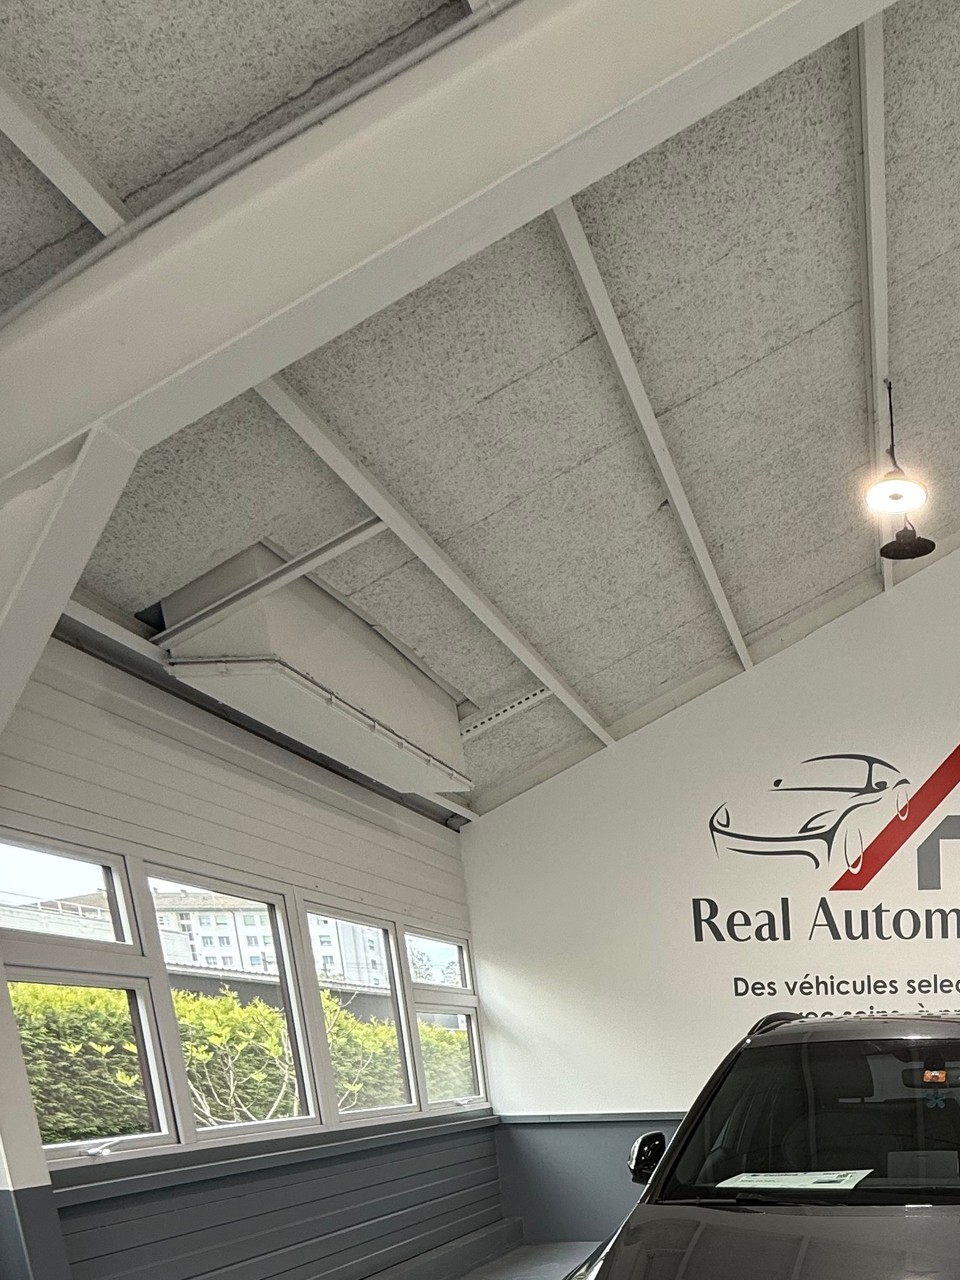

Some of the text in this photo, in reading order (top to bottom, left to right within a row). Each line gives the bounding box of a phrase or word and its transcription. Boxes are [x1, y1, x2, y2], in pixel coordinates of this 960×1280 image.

[691, 897, 791, 943] Real
[733, 976, 778, 997] Des
[783, 973, 899, 997] véhicules
